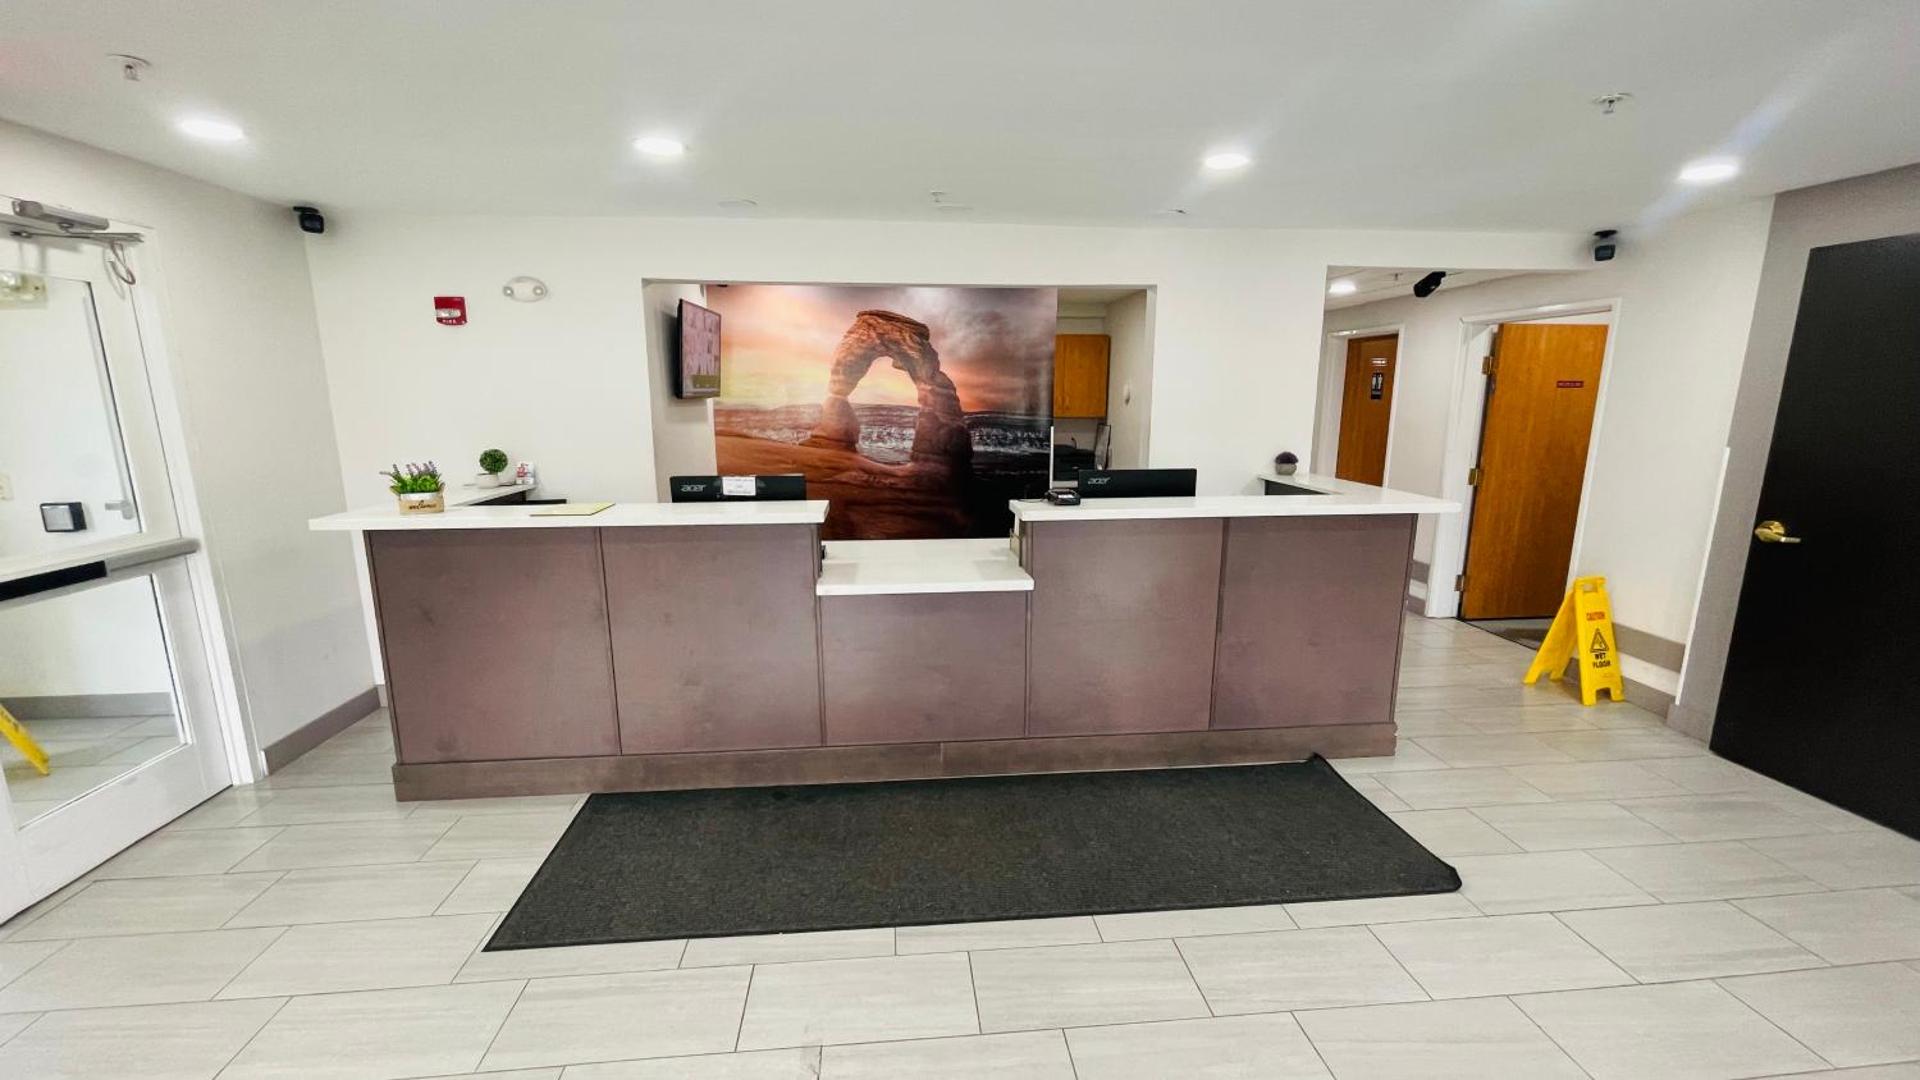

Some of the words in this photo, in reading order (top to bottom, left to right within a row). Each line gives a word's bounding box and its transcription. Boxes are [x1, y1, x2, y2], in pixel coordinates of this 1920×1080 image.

[1088, 477, 1111, 485] acer
[681, 484, 706, 492] acer
[1594, 652, 1606, 660] WET
[1592, 660, 1611, 669] FLOOR
